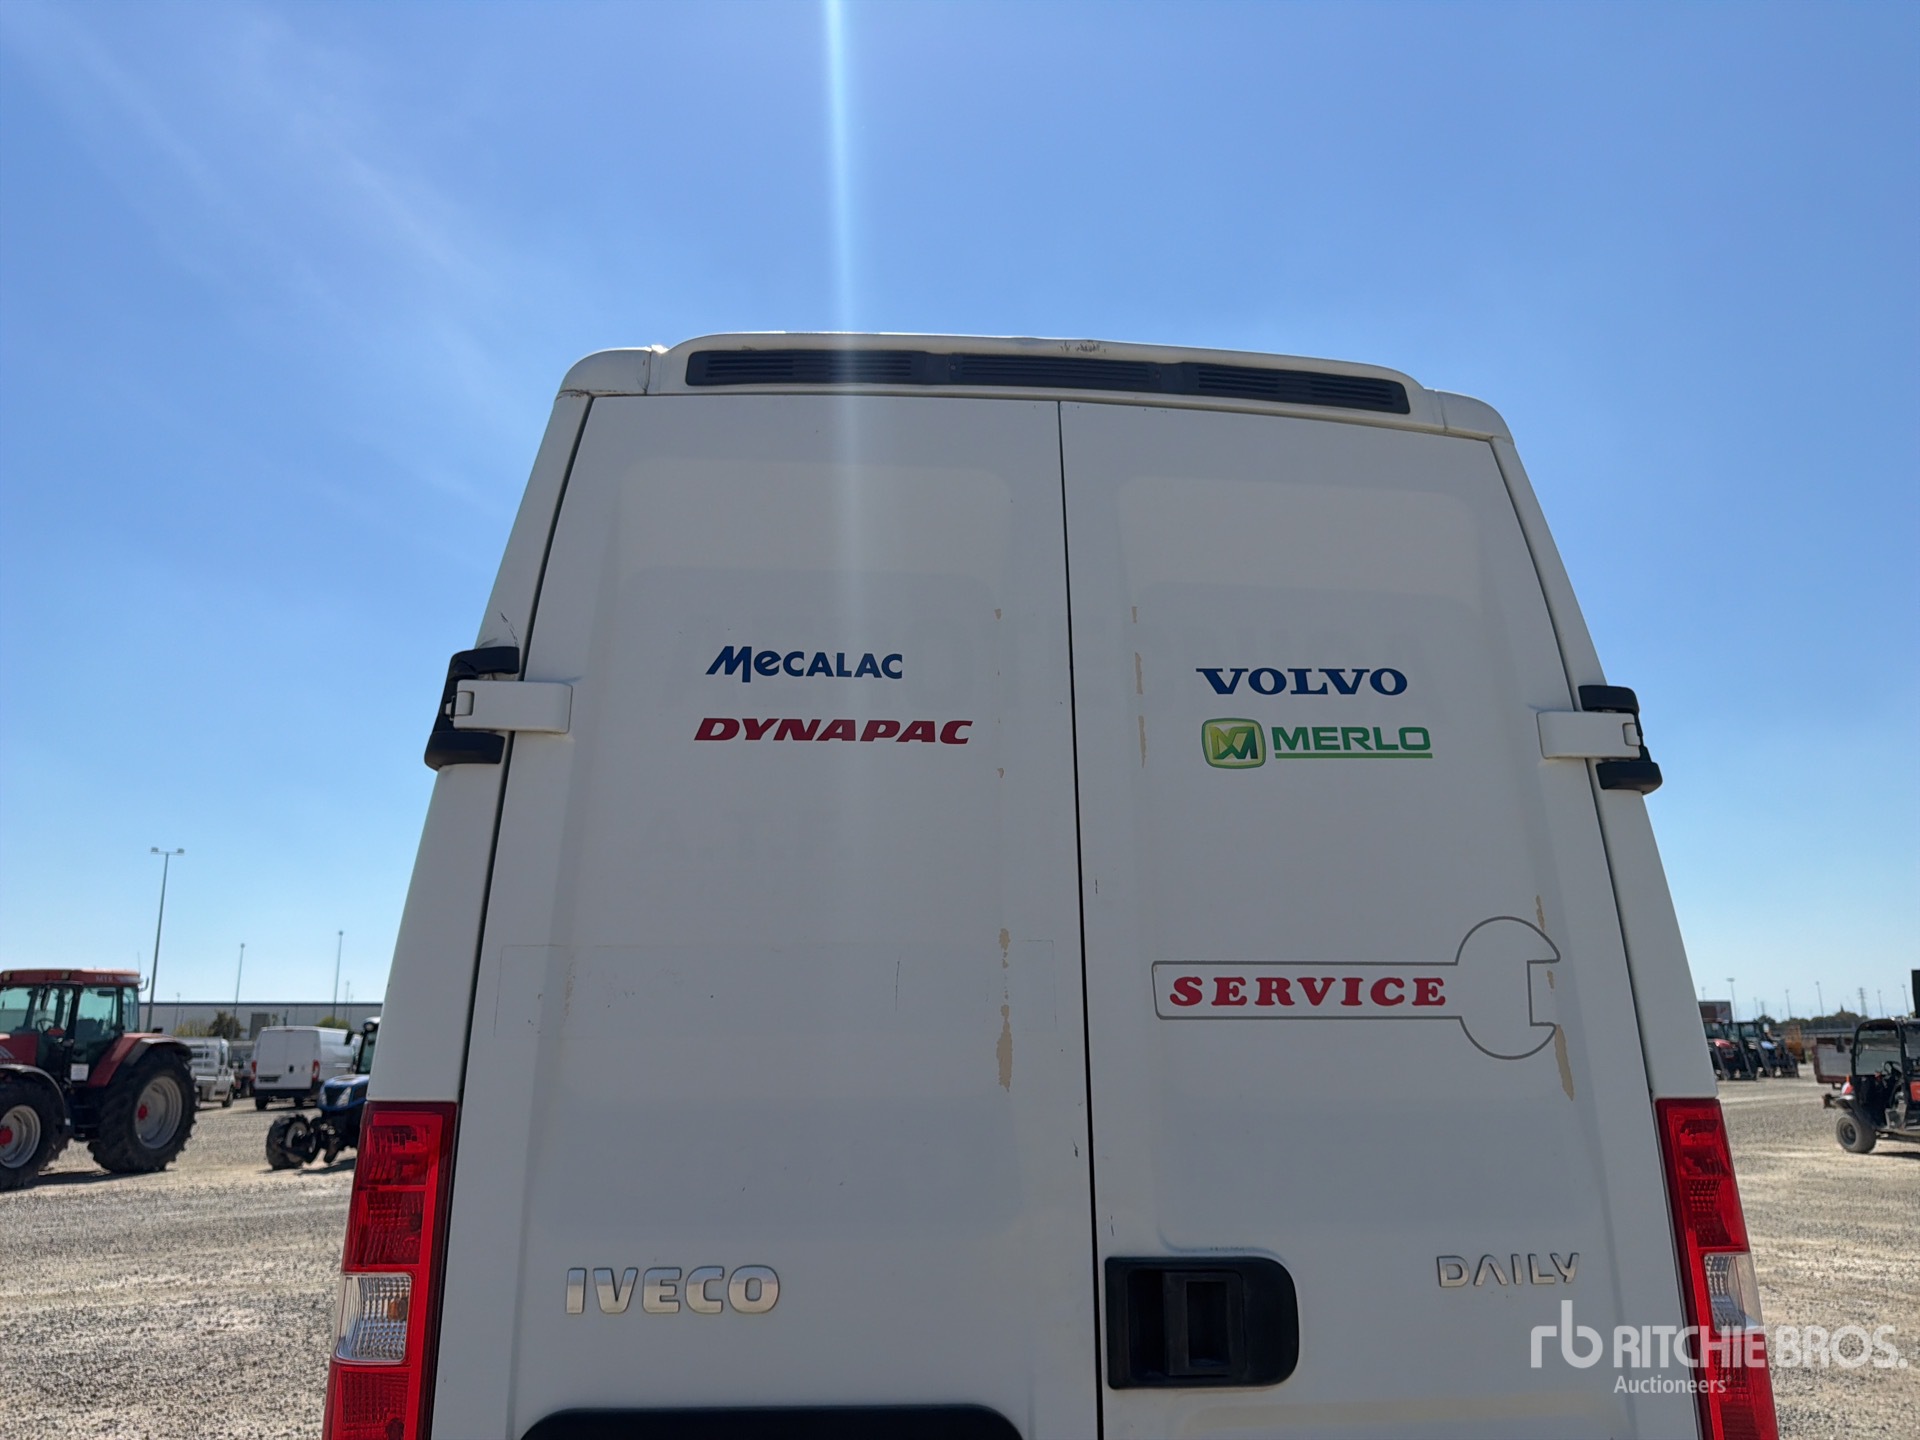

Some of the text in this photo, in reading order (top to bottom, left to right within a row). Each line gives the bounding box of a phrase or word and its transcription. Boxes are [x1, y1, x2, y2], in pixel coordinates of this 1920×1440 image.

[1195, 667, 1408, 696] VOLVO
[693, 717, 974, 745] DYNAPAC
[1271, 726, 1431, 751] MERLO
[1169, 976, 1446, 1007] SERVICE
[1436, 1252, 1580, 1288] DAILY
[565, 1264, 780, 1314] IVECO
